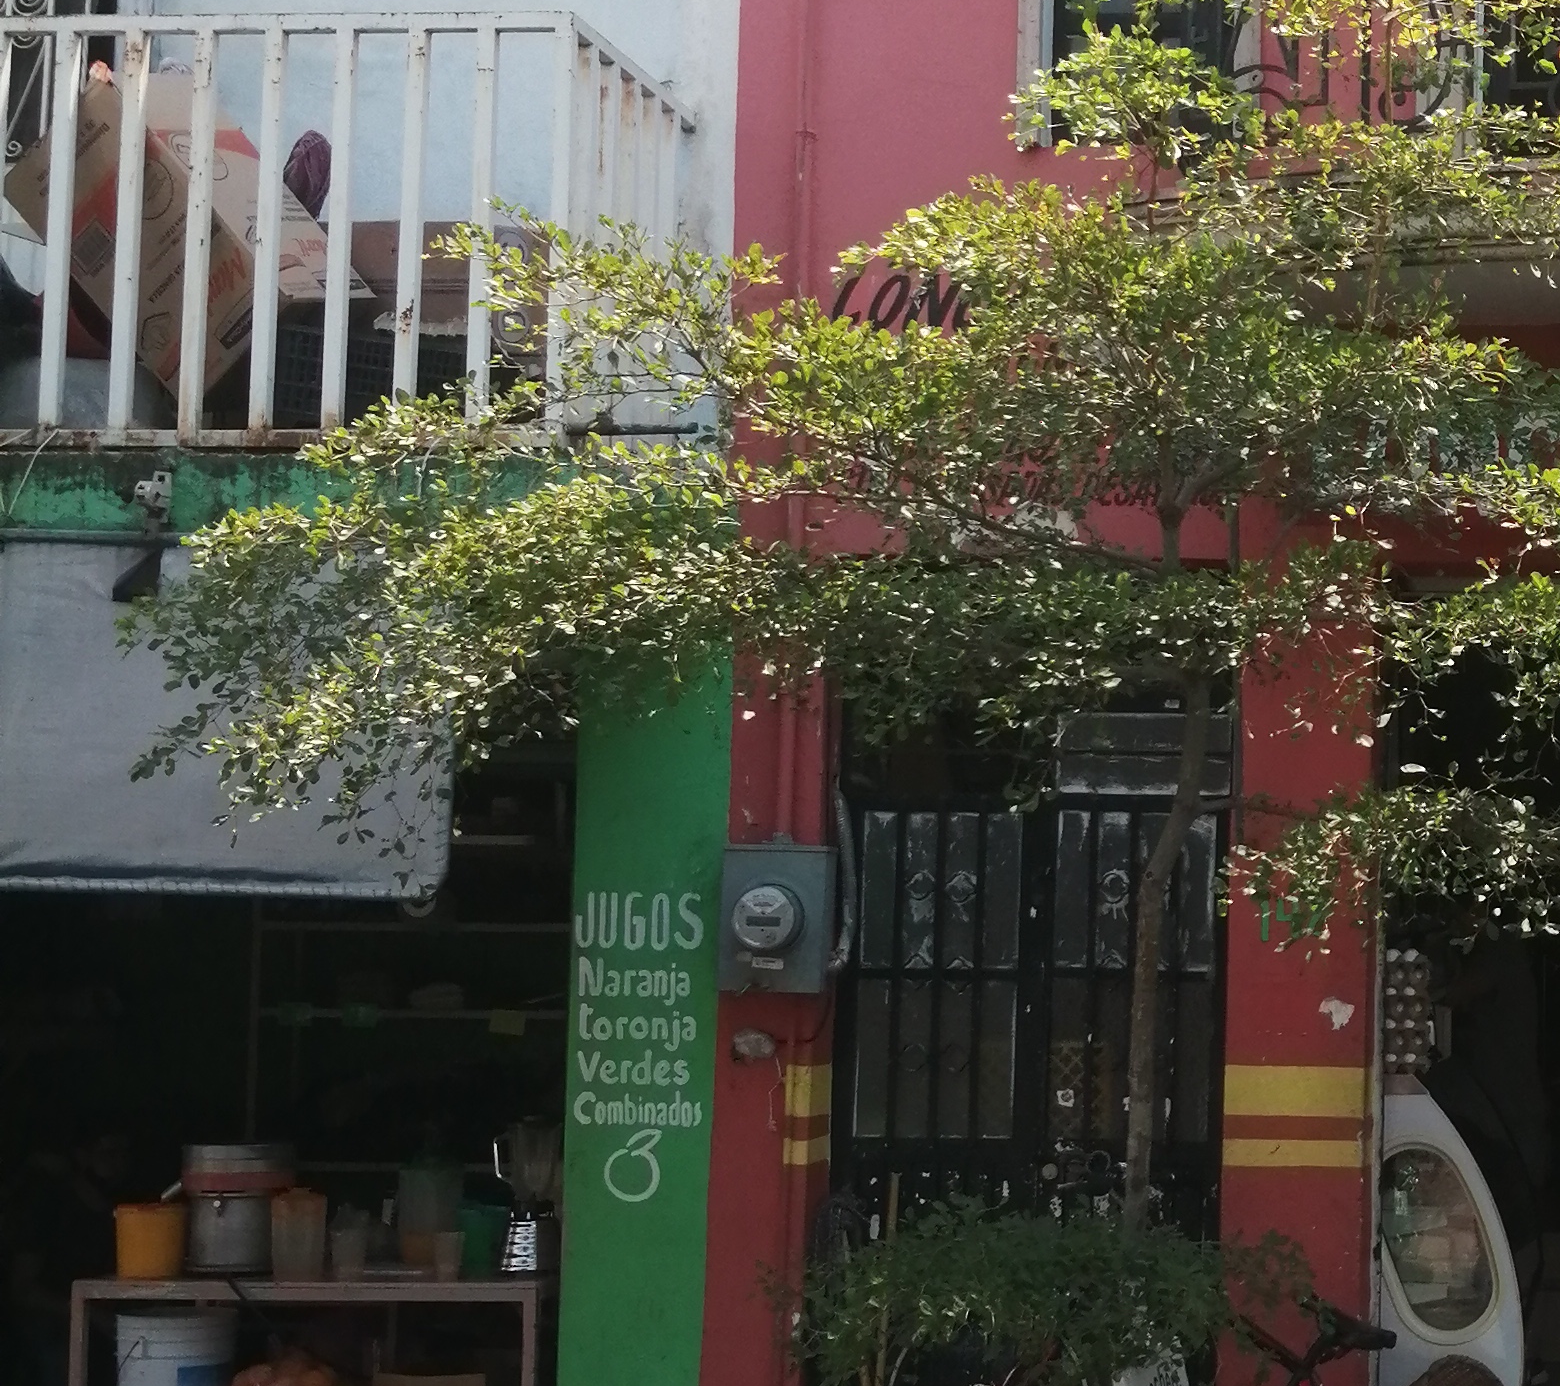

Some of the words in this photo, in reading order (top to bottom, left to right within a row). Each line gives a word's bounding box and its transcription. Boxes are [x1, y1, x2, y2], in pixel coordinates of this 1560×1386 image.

[574, 891, 704, 951] JUGOS
[578, 956, 691, 1006] Naranja
[577, 1049, 690, 1087] Verdes
[573, 1091, 702, 1127] Combinados
